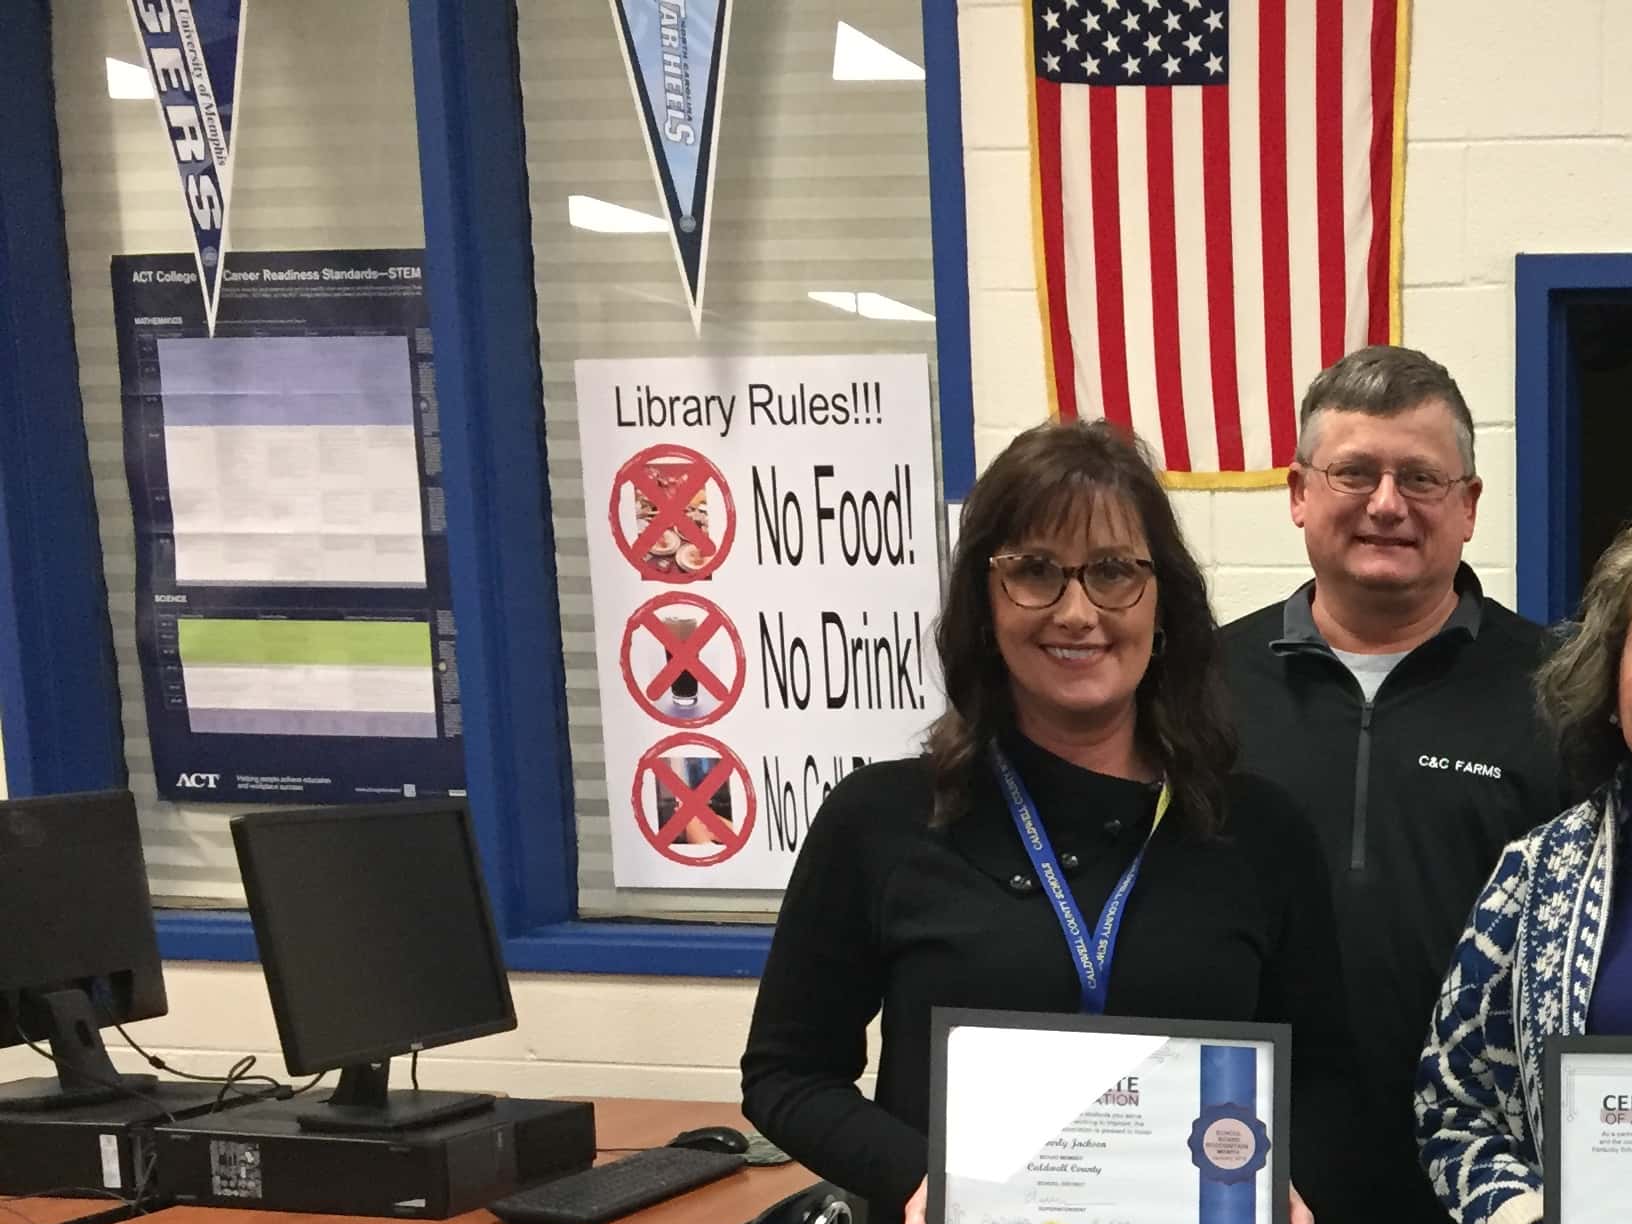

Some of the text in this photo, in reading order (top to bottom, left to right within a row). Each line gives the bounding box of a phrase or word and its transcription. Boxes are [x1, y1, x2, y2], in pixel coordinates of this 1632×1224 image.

[177, 8, 226, 167] University of Memphis
[132, 270, 153, 283] ACT
[156, 270, 197, 285] College
[223, 268, 260, 282] Career
[263, 267, 320, 281] Readiness
[613, 382, 883, 438] Library Rules!!!
[751, 463, 917, 567] No Food!
[758, 610, 926, 711] No Drink!
[176, 773, 221, 789] ACT
[763, 755, 799, 853] No
[1418, 755, 1502, 779] C&C FARMS
[1041, 861, 1097, 989] CALDWELL COUNTY SCHOOLS
[1605, 1112, 1625, 1125] OF
